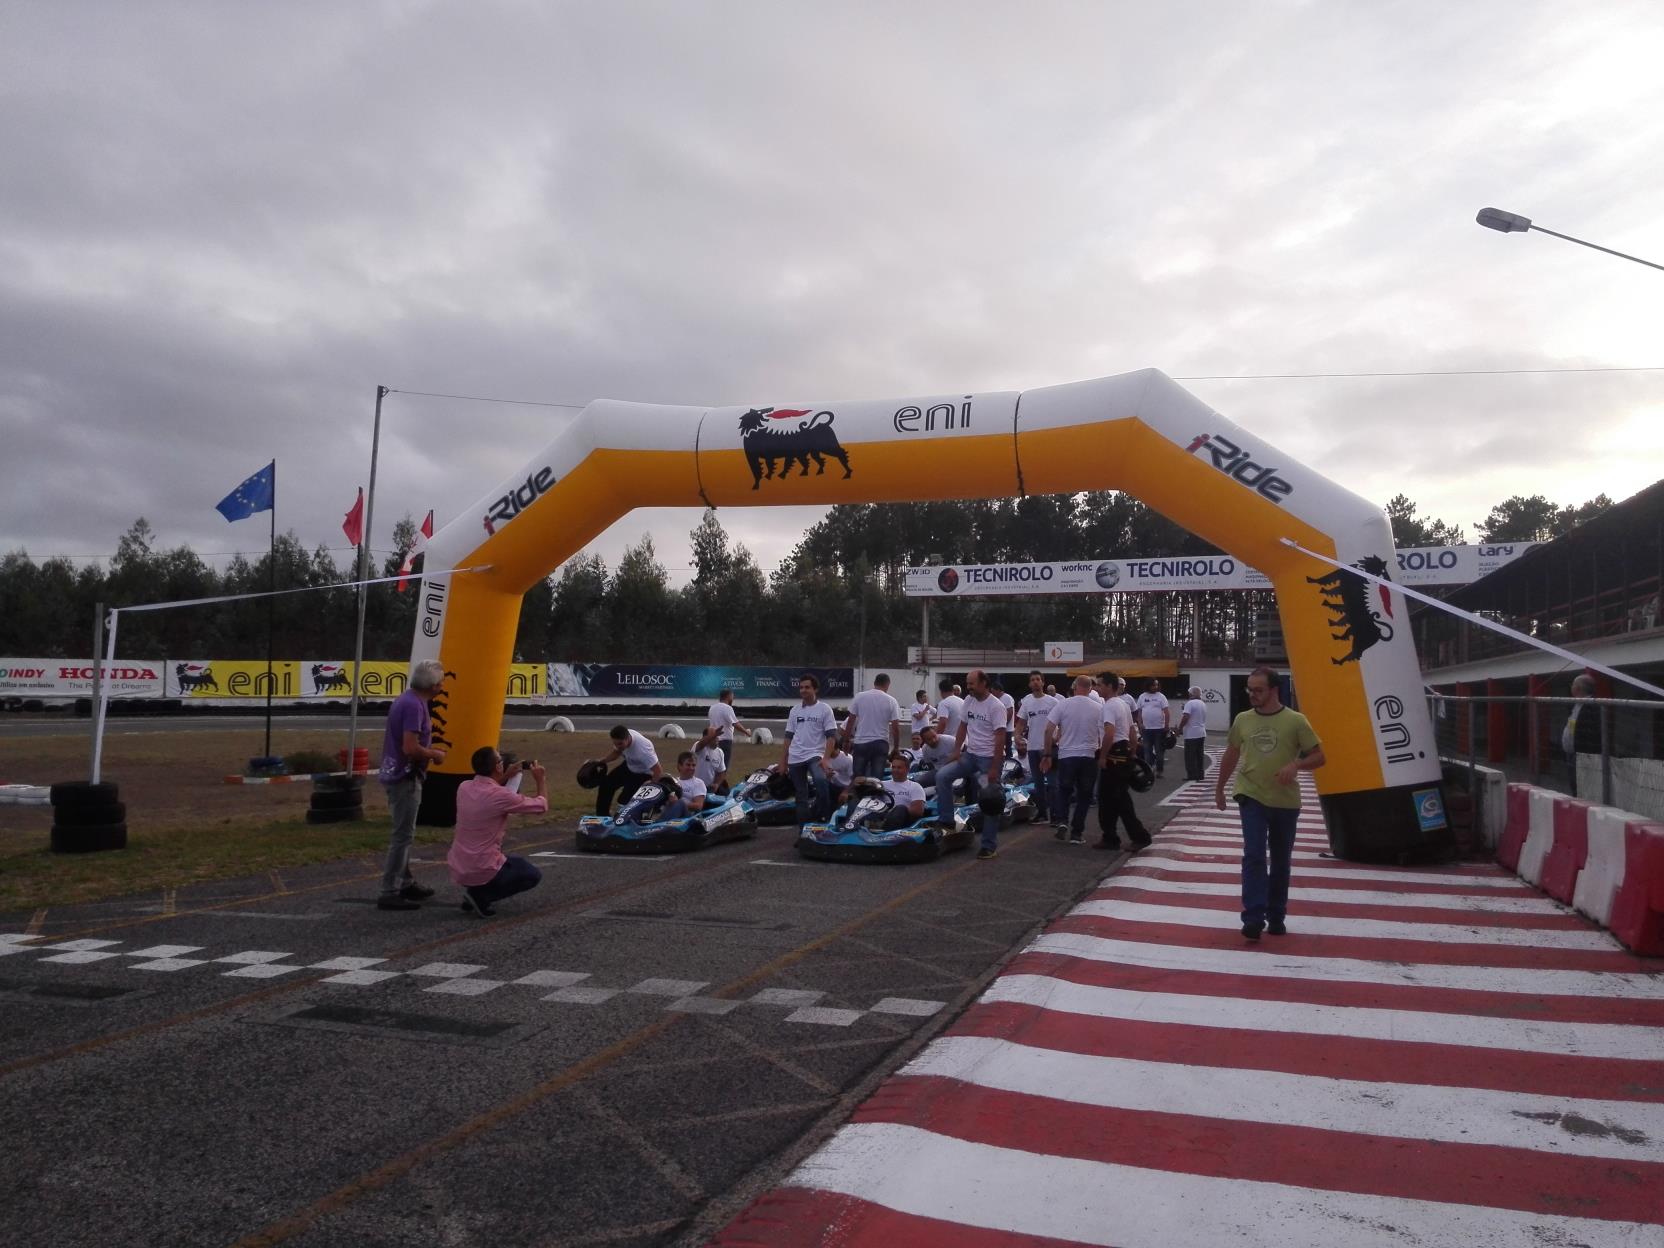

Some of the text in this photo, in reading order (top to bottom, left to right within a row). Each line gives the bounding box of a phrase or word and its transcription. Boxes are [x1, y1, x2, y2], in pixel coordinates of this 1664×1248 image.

[893, 394, 974, 433] eni
[1184, 432, 1294, 504] iRide
[483, 465, 557, 536] iRide
[1061, 562, 1093, 572] worknc
[1126, 558, 1235, 578] TECNIROLO
[1397, 550, 1458, 571] ROLO
[963, 565, 1054, 583] TECNIROLO
[422, 580, 446, 638] eni
[58, 667, 159, 680] HONDA
[228, 662, 291, 696] eni
[360, 670, 408, 695] en
[508, 665, 539, 696] ni
[616, 672, 674, 685] LEILOSOC
[1373, 694, 1426, 764] eni
[637, 787, 653, 798] 26
[864, 798, 880, 810] 12
